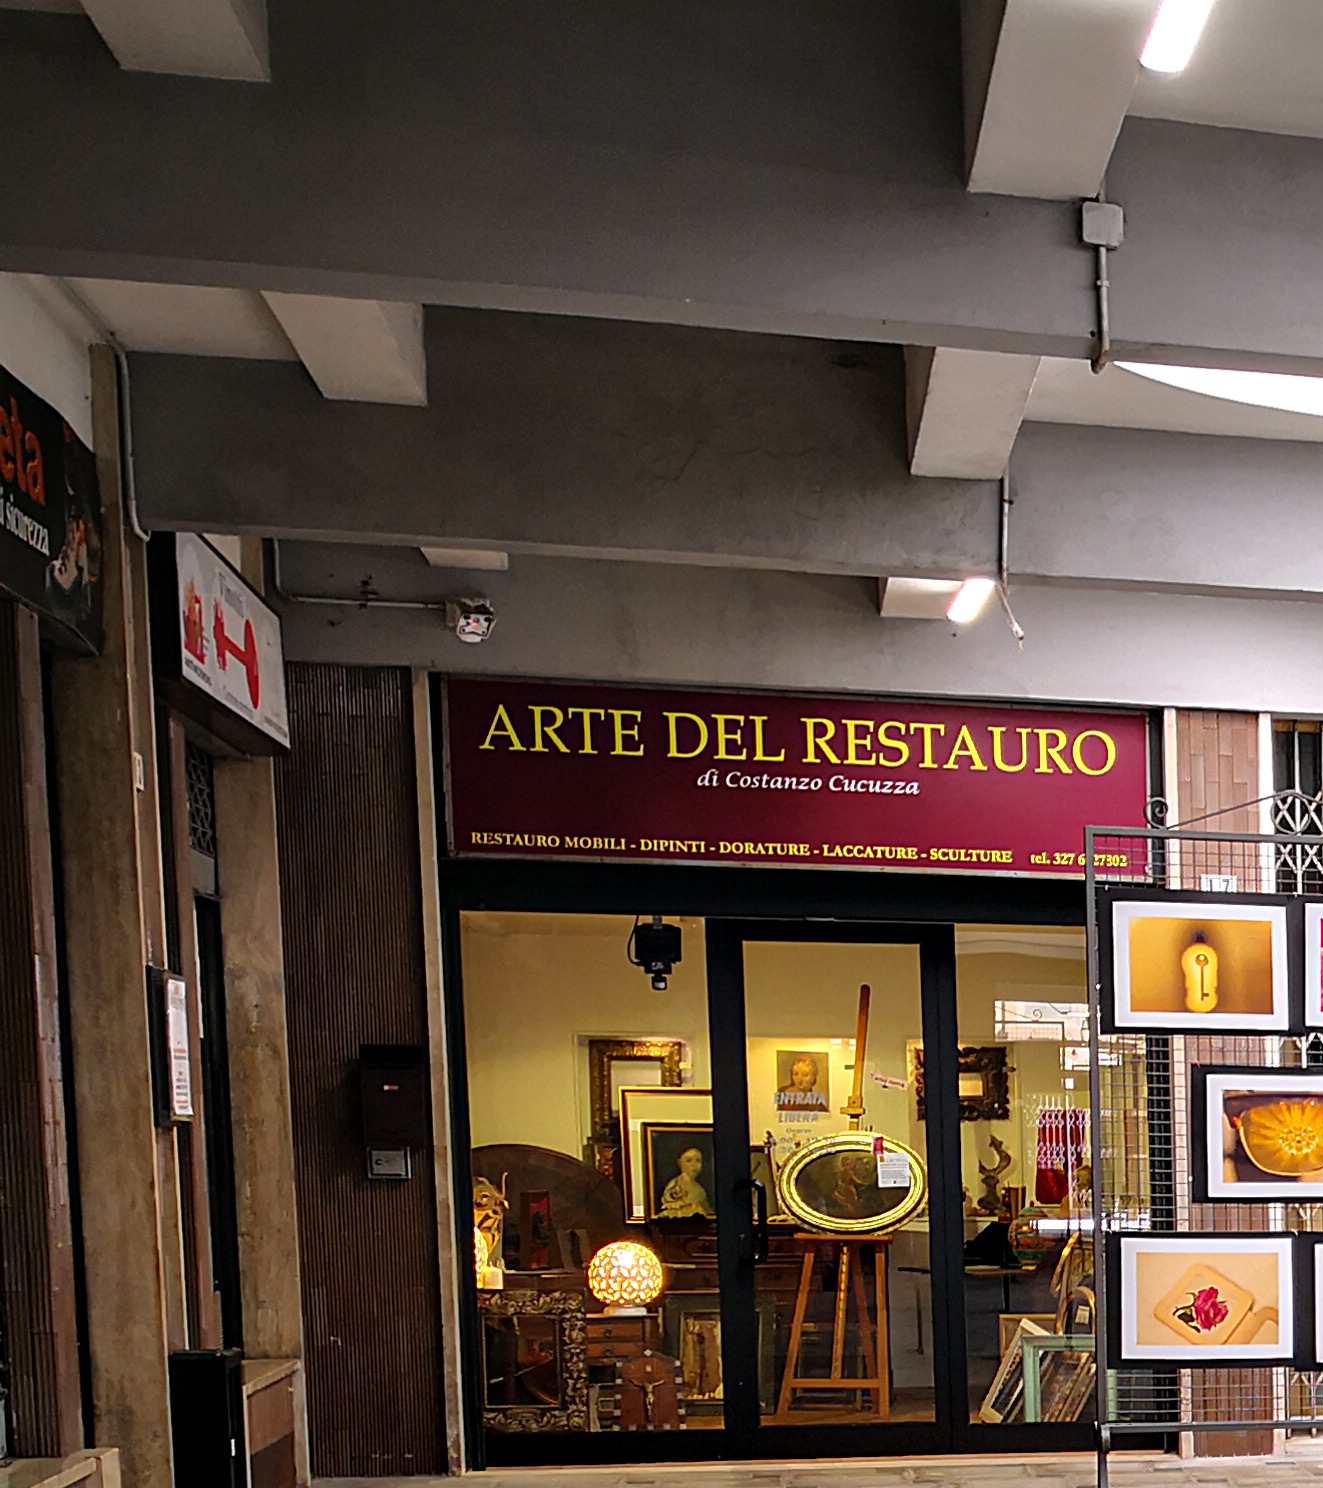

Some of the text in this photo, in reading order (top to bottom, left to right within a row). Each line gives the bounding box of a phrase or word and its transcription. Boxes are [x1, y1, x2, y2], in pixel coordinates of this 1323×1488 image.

[479, 704, 1118, 777] ARTE DEL RESTAURO
[697, 769, 920, 797] di Costanzo Cucuzza
[471, 831, 560, 848] RESTAURO
[564, 836, 626, 850] MOBILI
[640, 839, 706, 853] DIPINTI
[719, 841, 810, 857] DORATURE
[823, 845, 918, 860] LACCATURE
[930, 848, 1013, 864] SCULTURE
[1030, 851, 1051, 864] tel.
[1053, 852, 1076, 865] 327
[1078, 853, 1128, 867] 627302
[774, 1091, 827, 1106] ENTRATA
[778, 1111, 819, 1124] LIBERA
